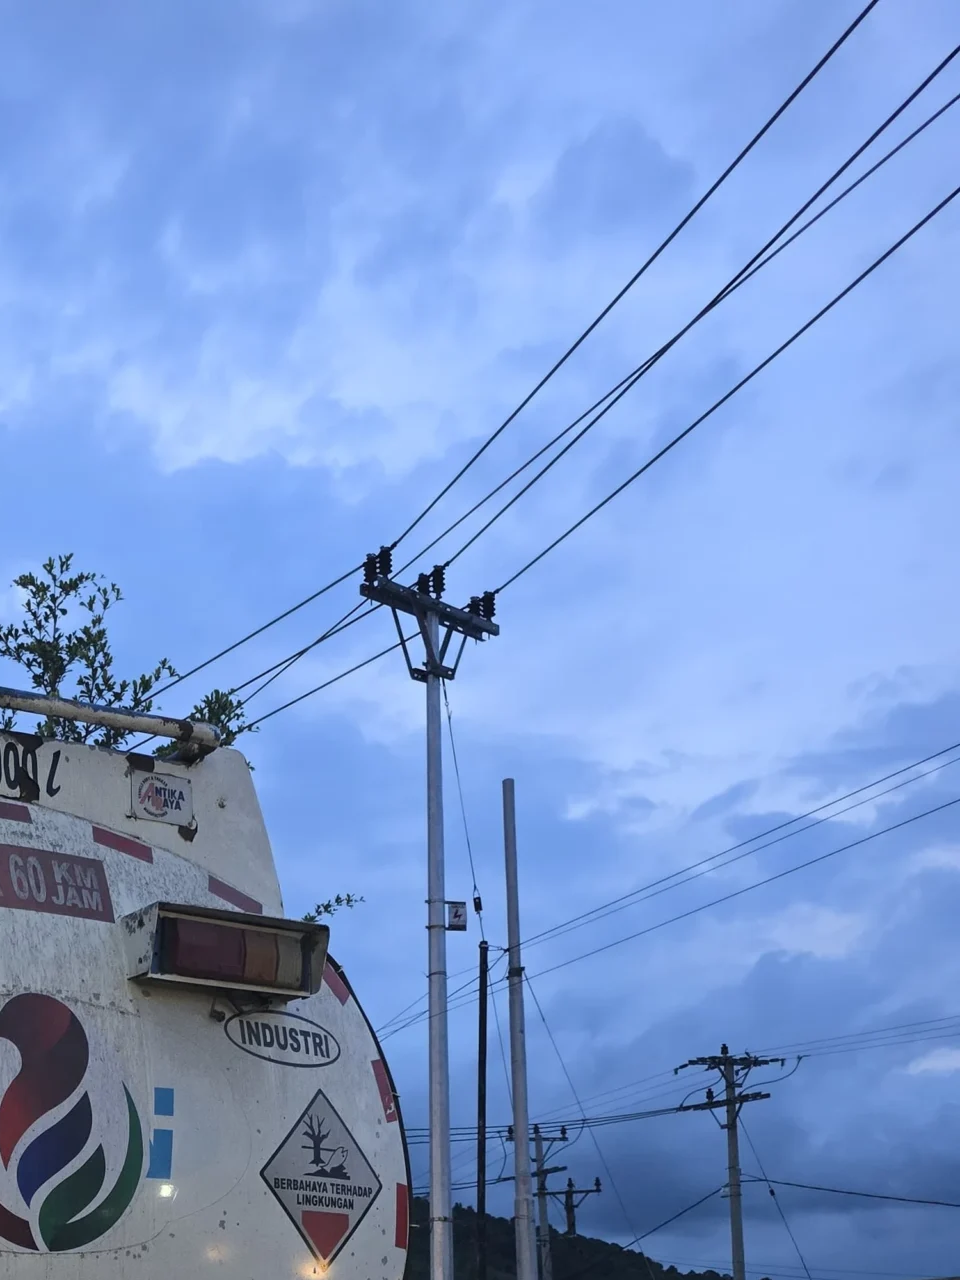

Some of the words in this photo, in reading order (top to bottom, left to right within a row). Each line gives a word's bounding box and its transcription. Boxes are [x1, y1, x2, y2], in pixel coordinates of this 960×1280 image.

[8, 853, 46, 903] 60
[52, 860, 98, 890] KM
[51, 885, 103, 912] JAM
[239, 1019, 330, 1059] INDUSTRI
[273, 1177, 328, 1194] BERBAHAYA
[330, 1182, 373, 1199] TERHADAP
[296, 1193, 354, 1211] LINGKUNGAN
